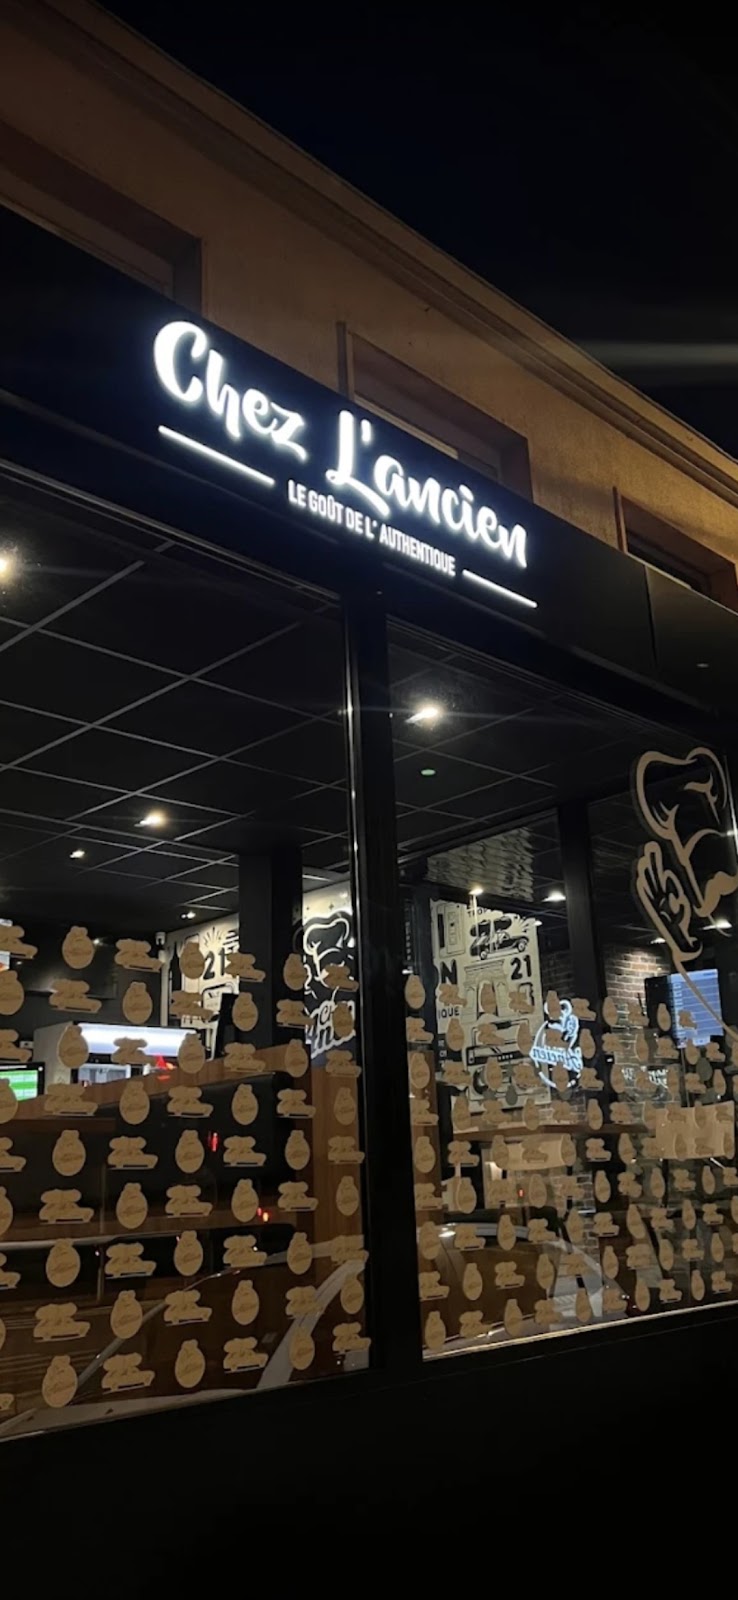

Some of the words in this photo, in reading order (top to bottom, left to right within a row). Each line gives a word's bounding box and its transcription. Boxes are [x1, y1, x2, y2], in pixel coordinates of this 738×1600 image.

[153, 320, 308, 461] Chez
[325, 409, 528, 569] L'ancien
[287, 479, 307, 508] LE
[307, 490, 343, 525] GOÛT
[344, 506, 364, 534] DE
[364, 515, 378, 540] L'
[378, 523, 457, 577] AUTHENTIQUE
[203, 947, 225, 980] 21
[511, 954, 532, 981] 21
